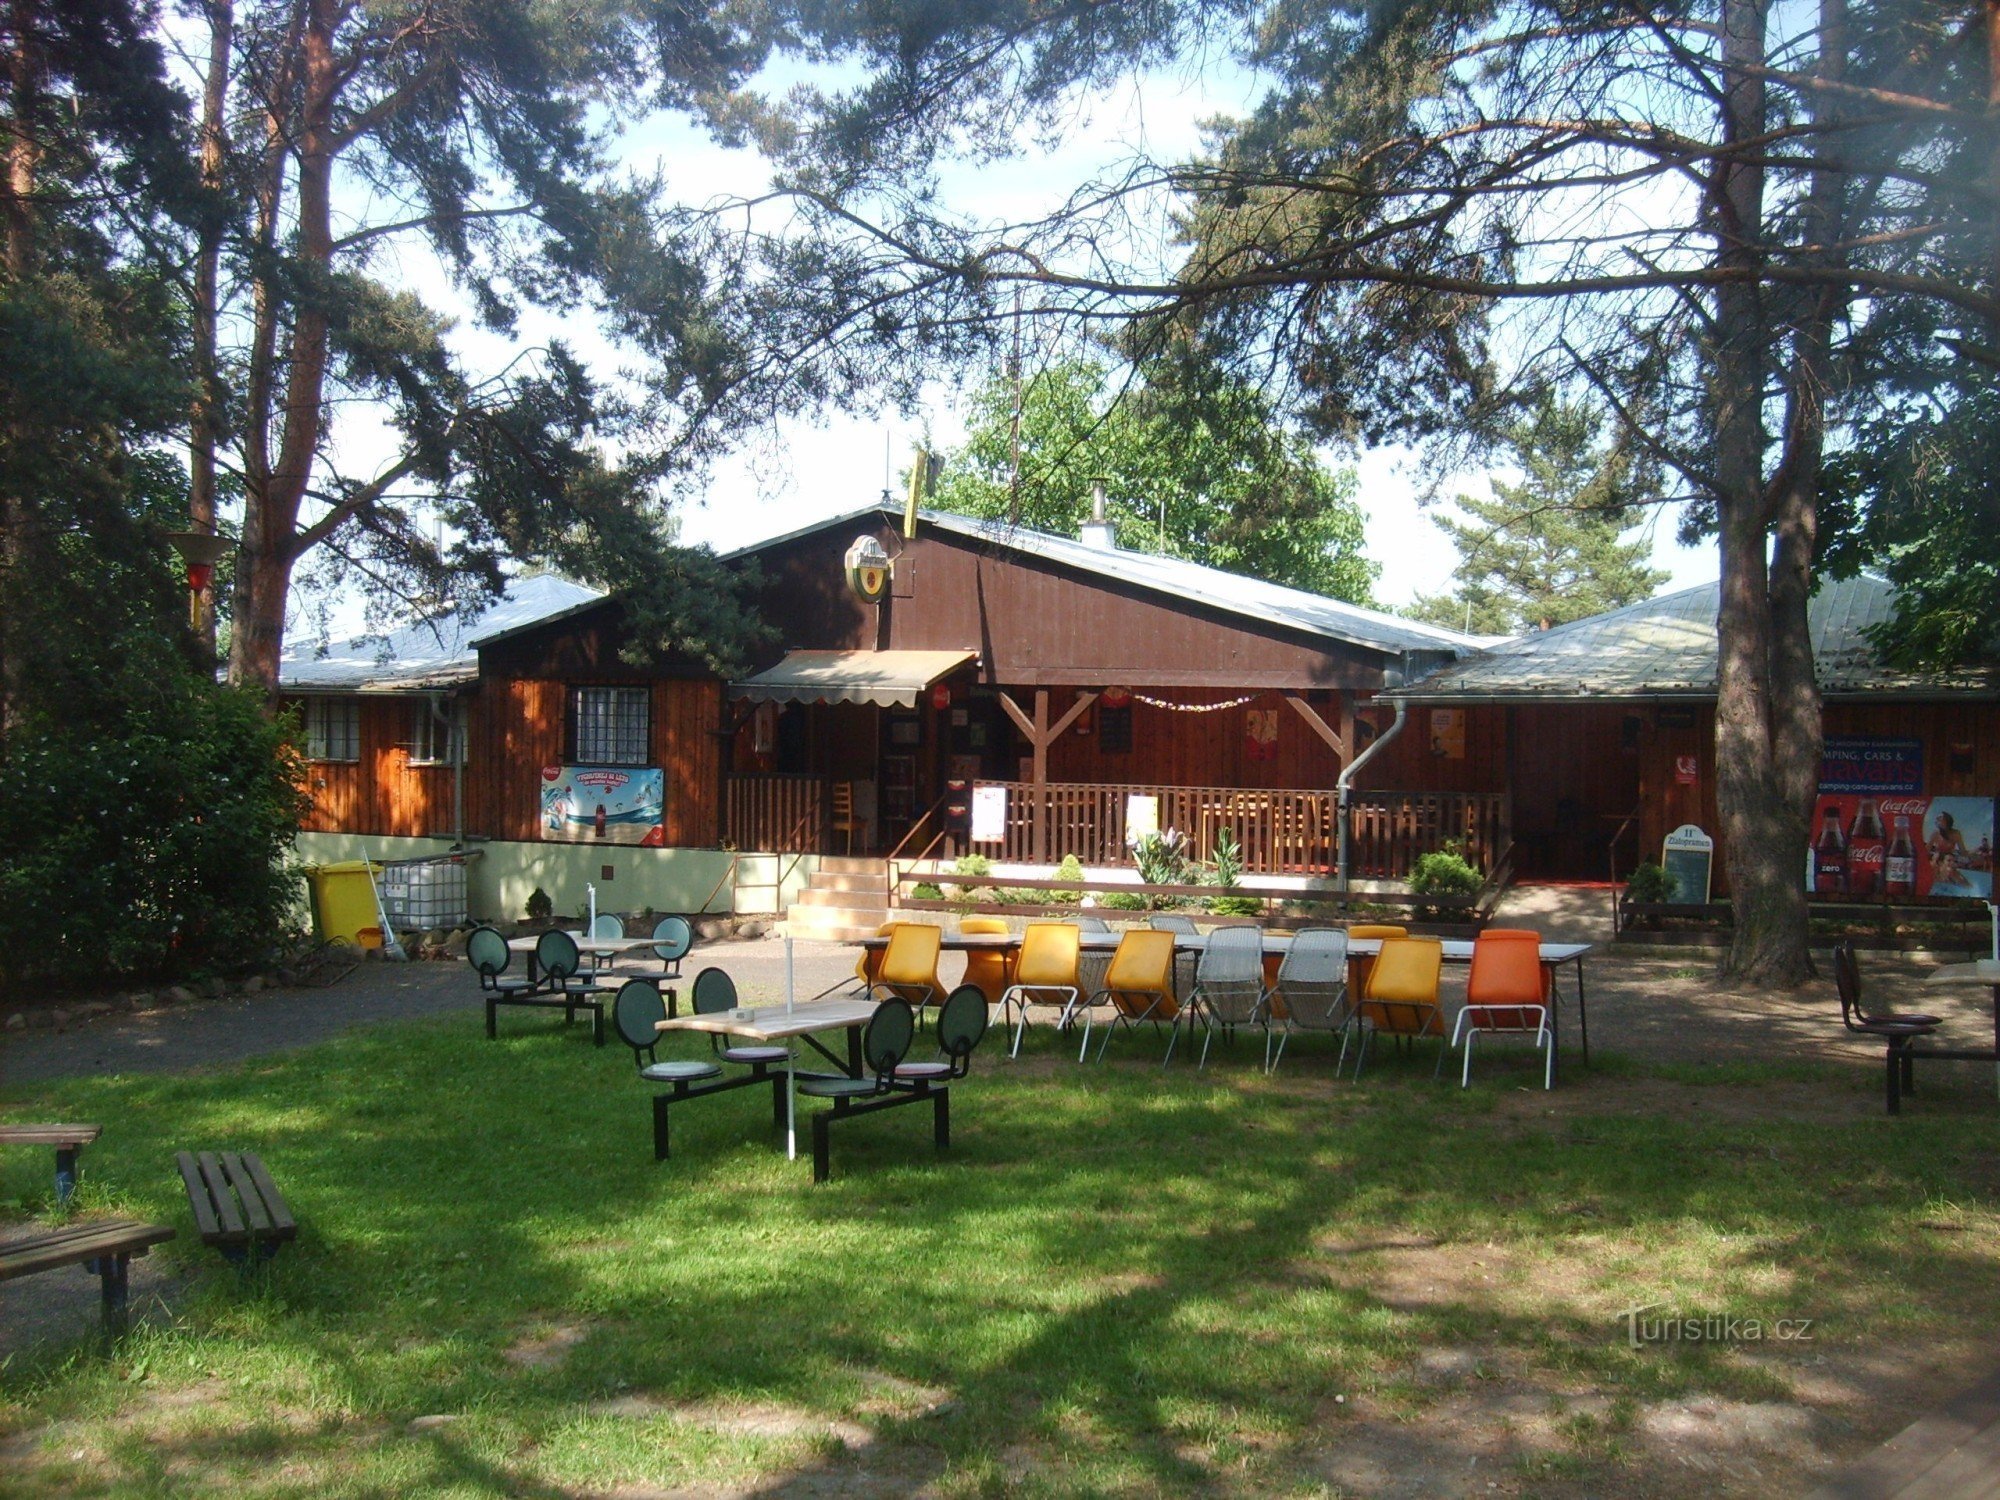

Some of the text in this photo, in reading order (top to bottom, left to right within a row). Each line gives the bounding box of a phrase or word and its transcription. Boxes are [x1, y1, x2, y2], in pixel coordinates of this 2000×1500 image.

[1822, 751, 1904, 761] MPING, CARS &
[1880, 799, 1926, 815] Coca-Cola
